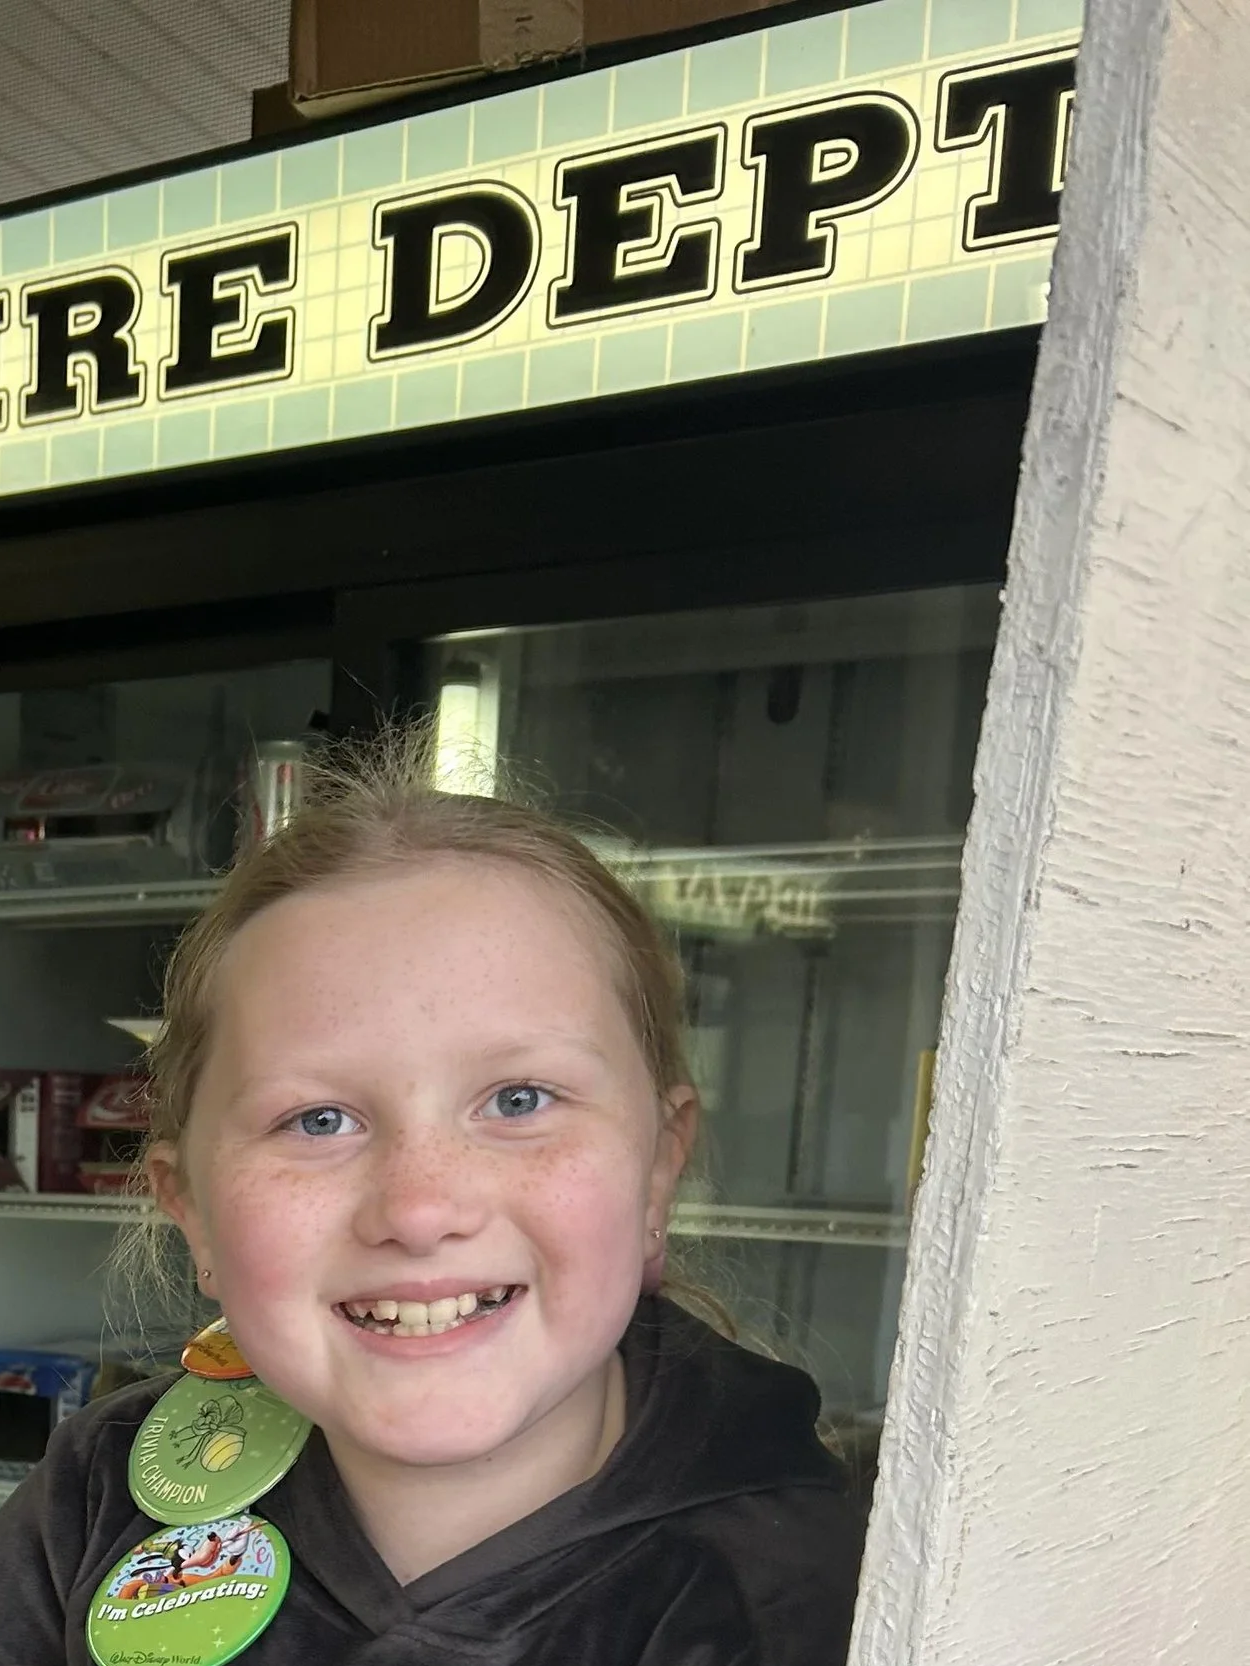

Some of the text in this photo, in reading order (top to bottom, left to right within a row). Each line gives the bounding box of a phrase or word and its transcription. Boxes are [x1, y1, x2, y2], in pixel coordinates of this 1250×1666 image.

[368, 44, 1080, 362] DEPT
[139, 1416, 208, 1504] TRIVIA CHAMPION
[97, 1579, 269, 1621] I'm Celebrating:
[110, 1651, 134, 1665] Walt
[171, 1655, 201, 1665] World
